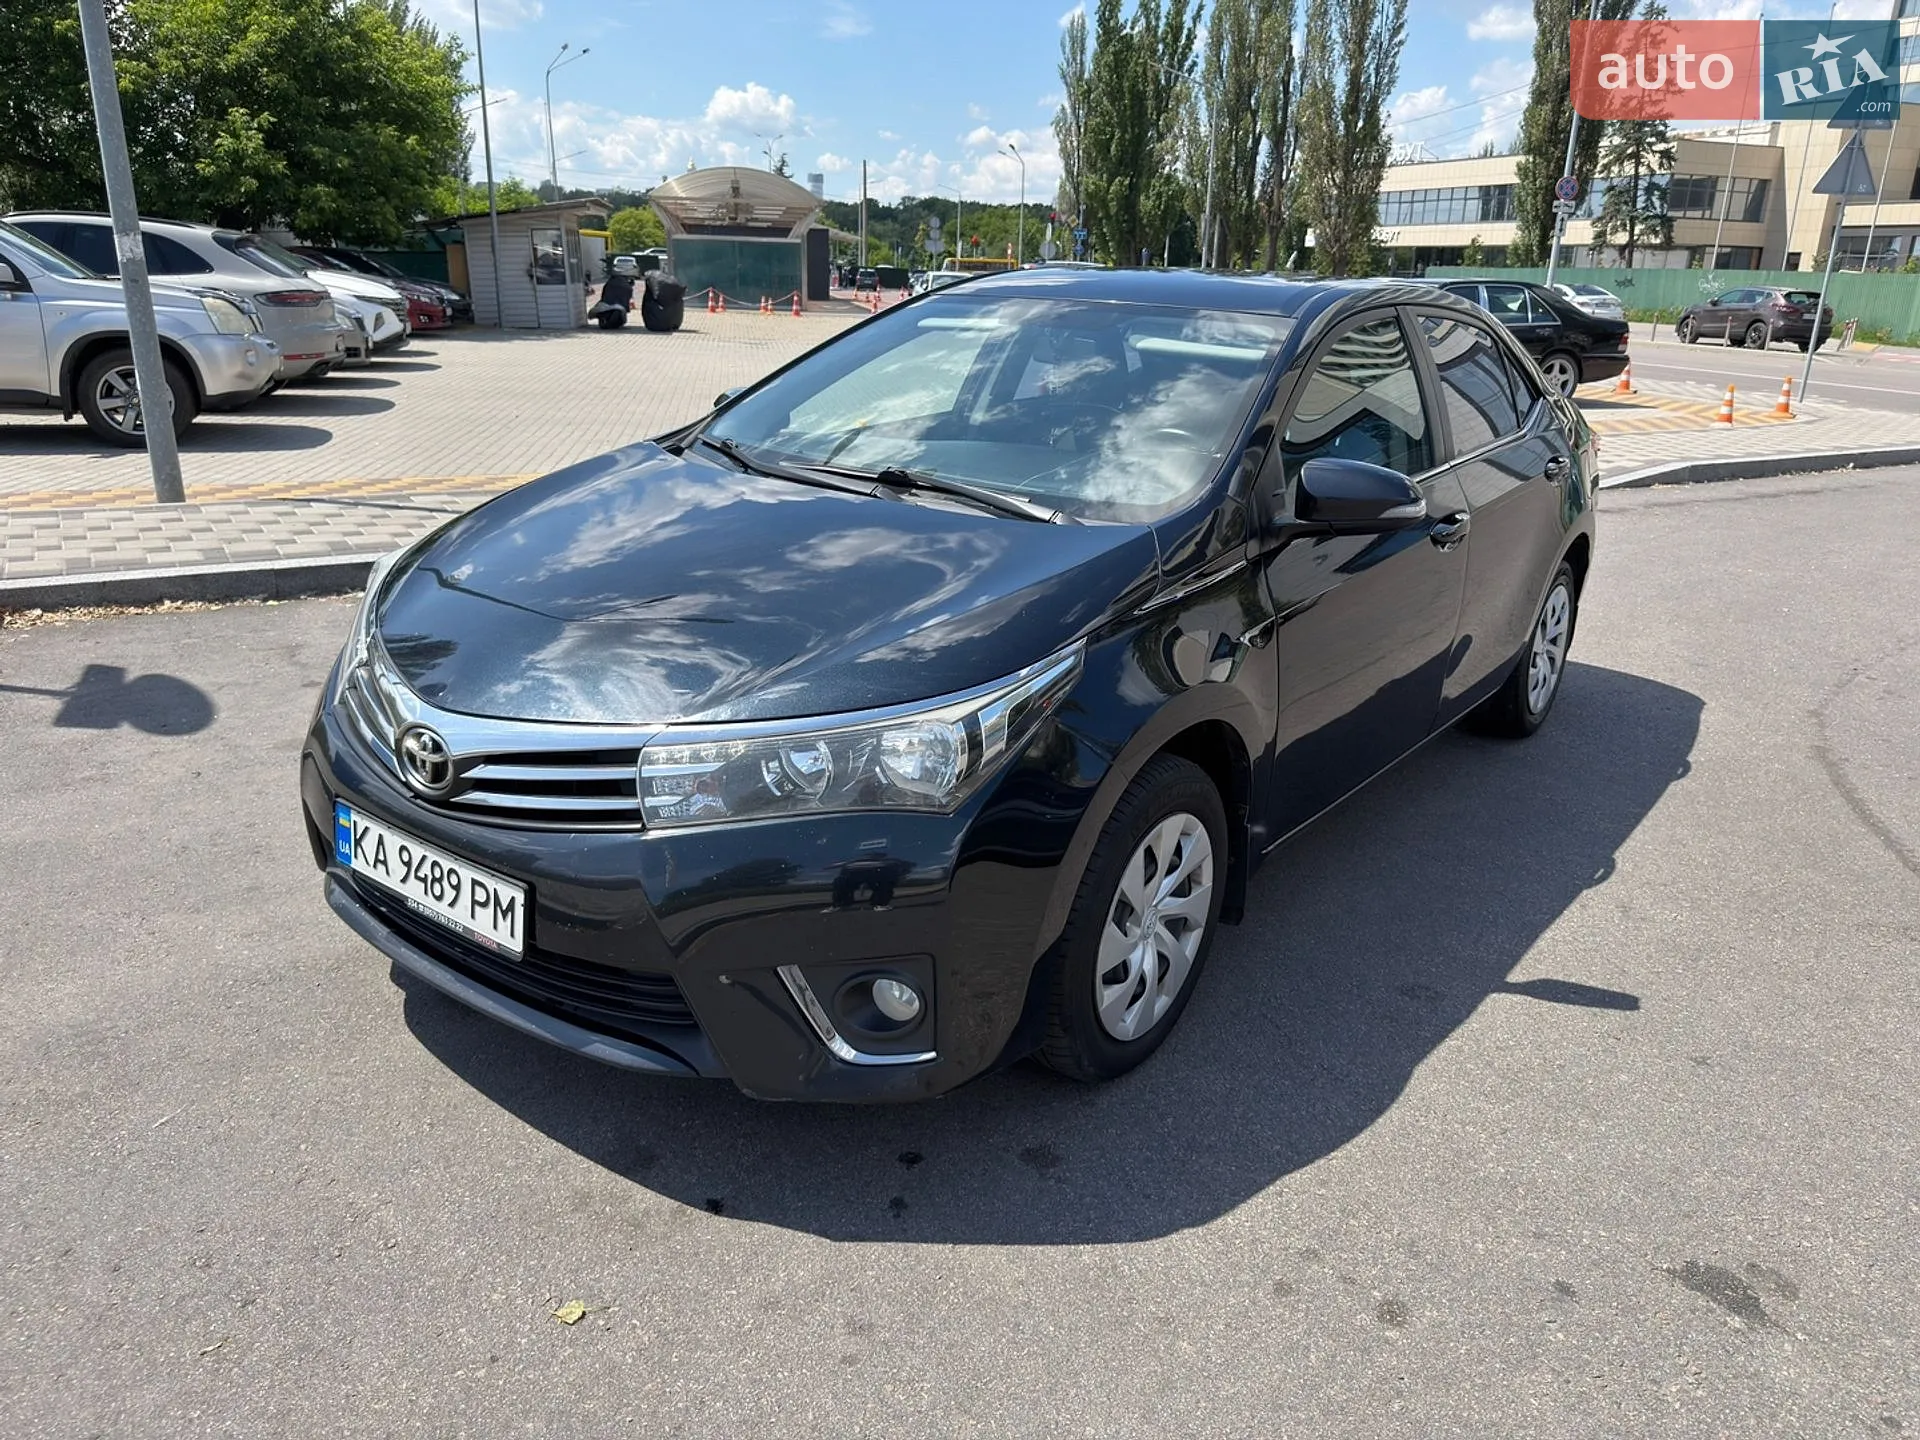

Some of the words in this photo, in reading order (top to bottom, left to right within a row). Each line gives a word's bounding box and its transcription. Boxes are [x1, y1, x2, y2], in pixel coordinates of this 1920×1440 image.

[339, 839, 351, 856] UA
[353, 820, 390, 877] KA
[398, 844, 461, 908] 9489
[470, 878, 518, 941] PM
